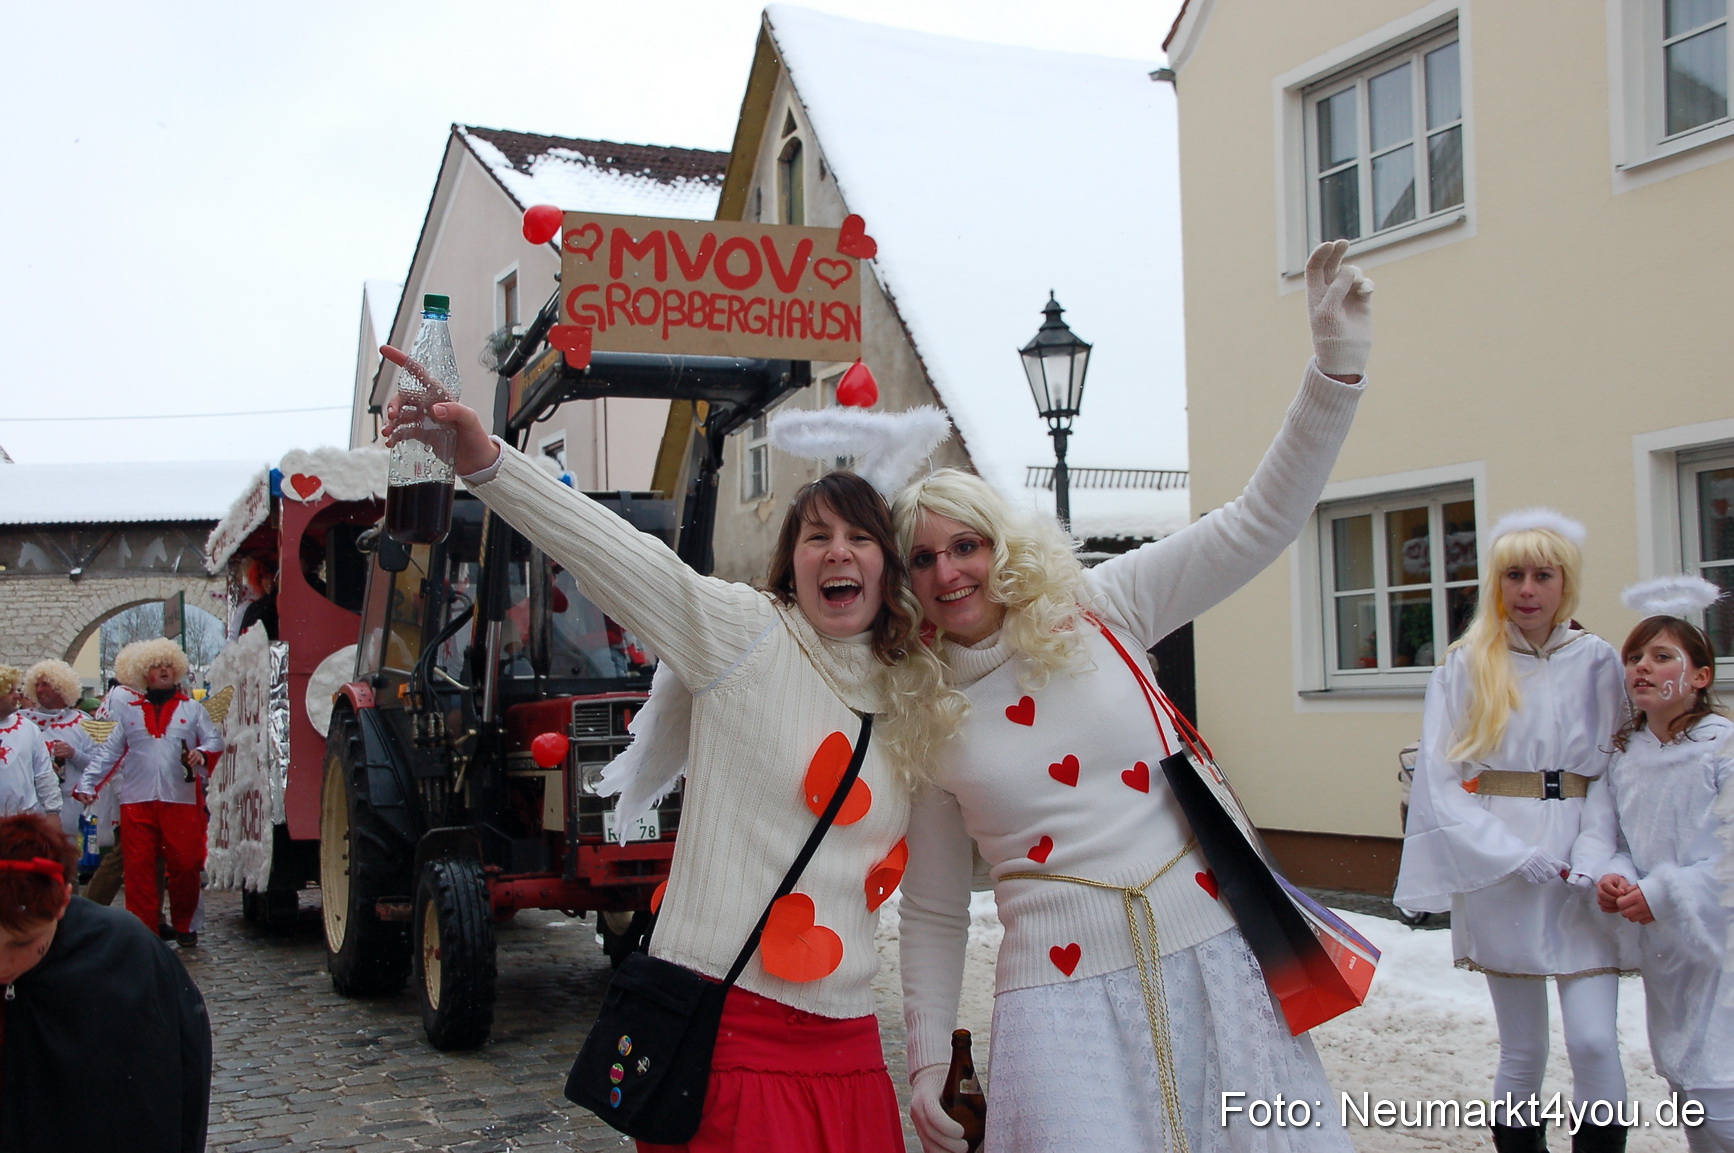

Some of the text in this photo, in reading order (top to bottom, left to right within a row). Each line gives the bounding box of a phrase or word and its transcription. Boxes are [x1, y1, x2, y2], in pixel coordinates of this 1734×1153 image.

[609, 226, 814, 294] MVOV
[565, 282, 861, 343] GROßBERGHAUSN
[639, 825, 657, 839] 78
